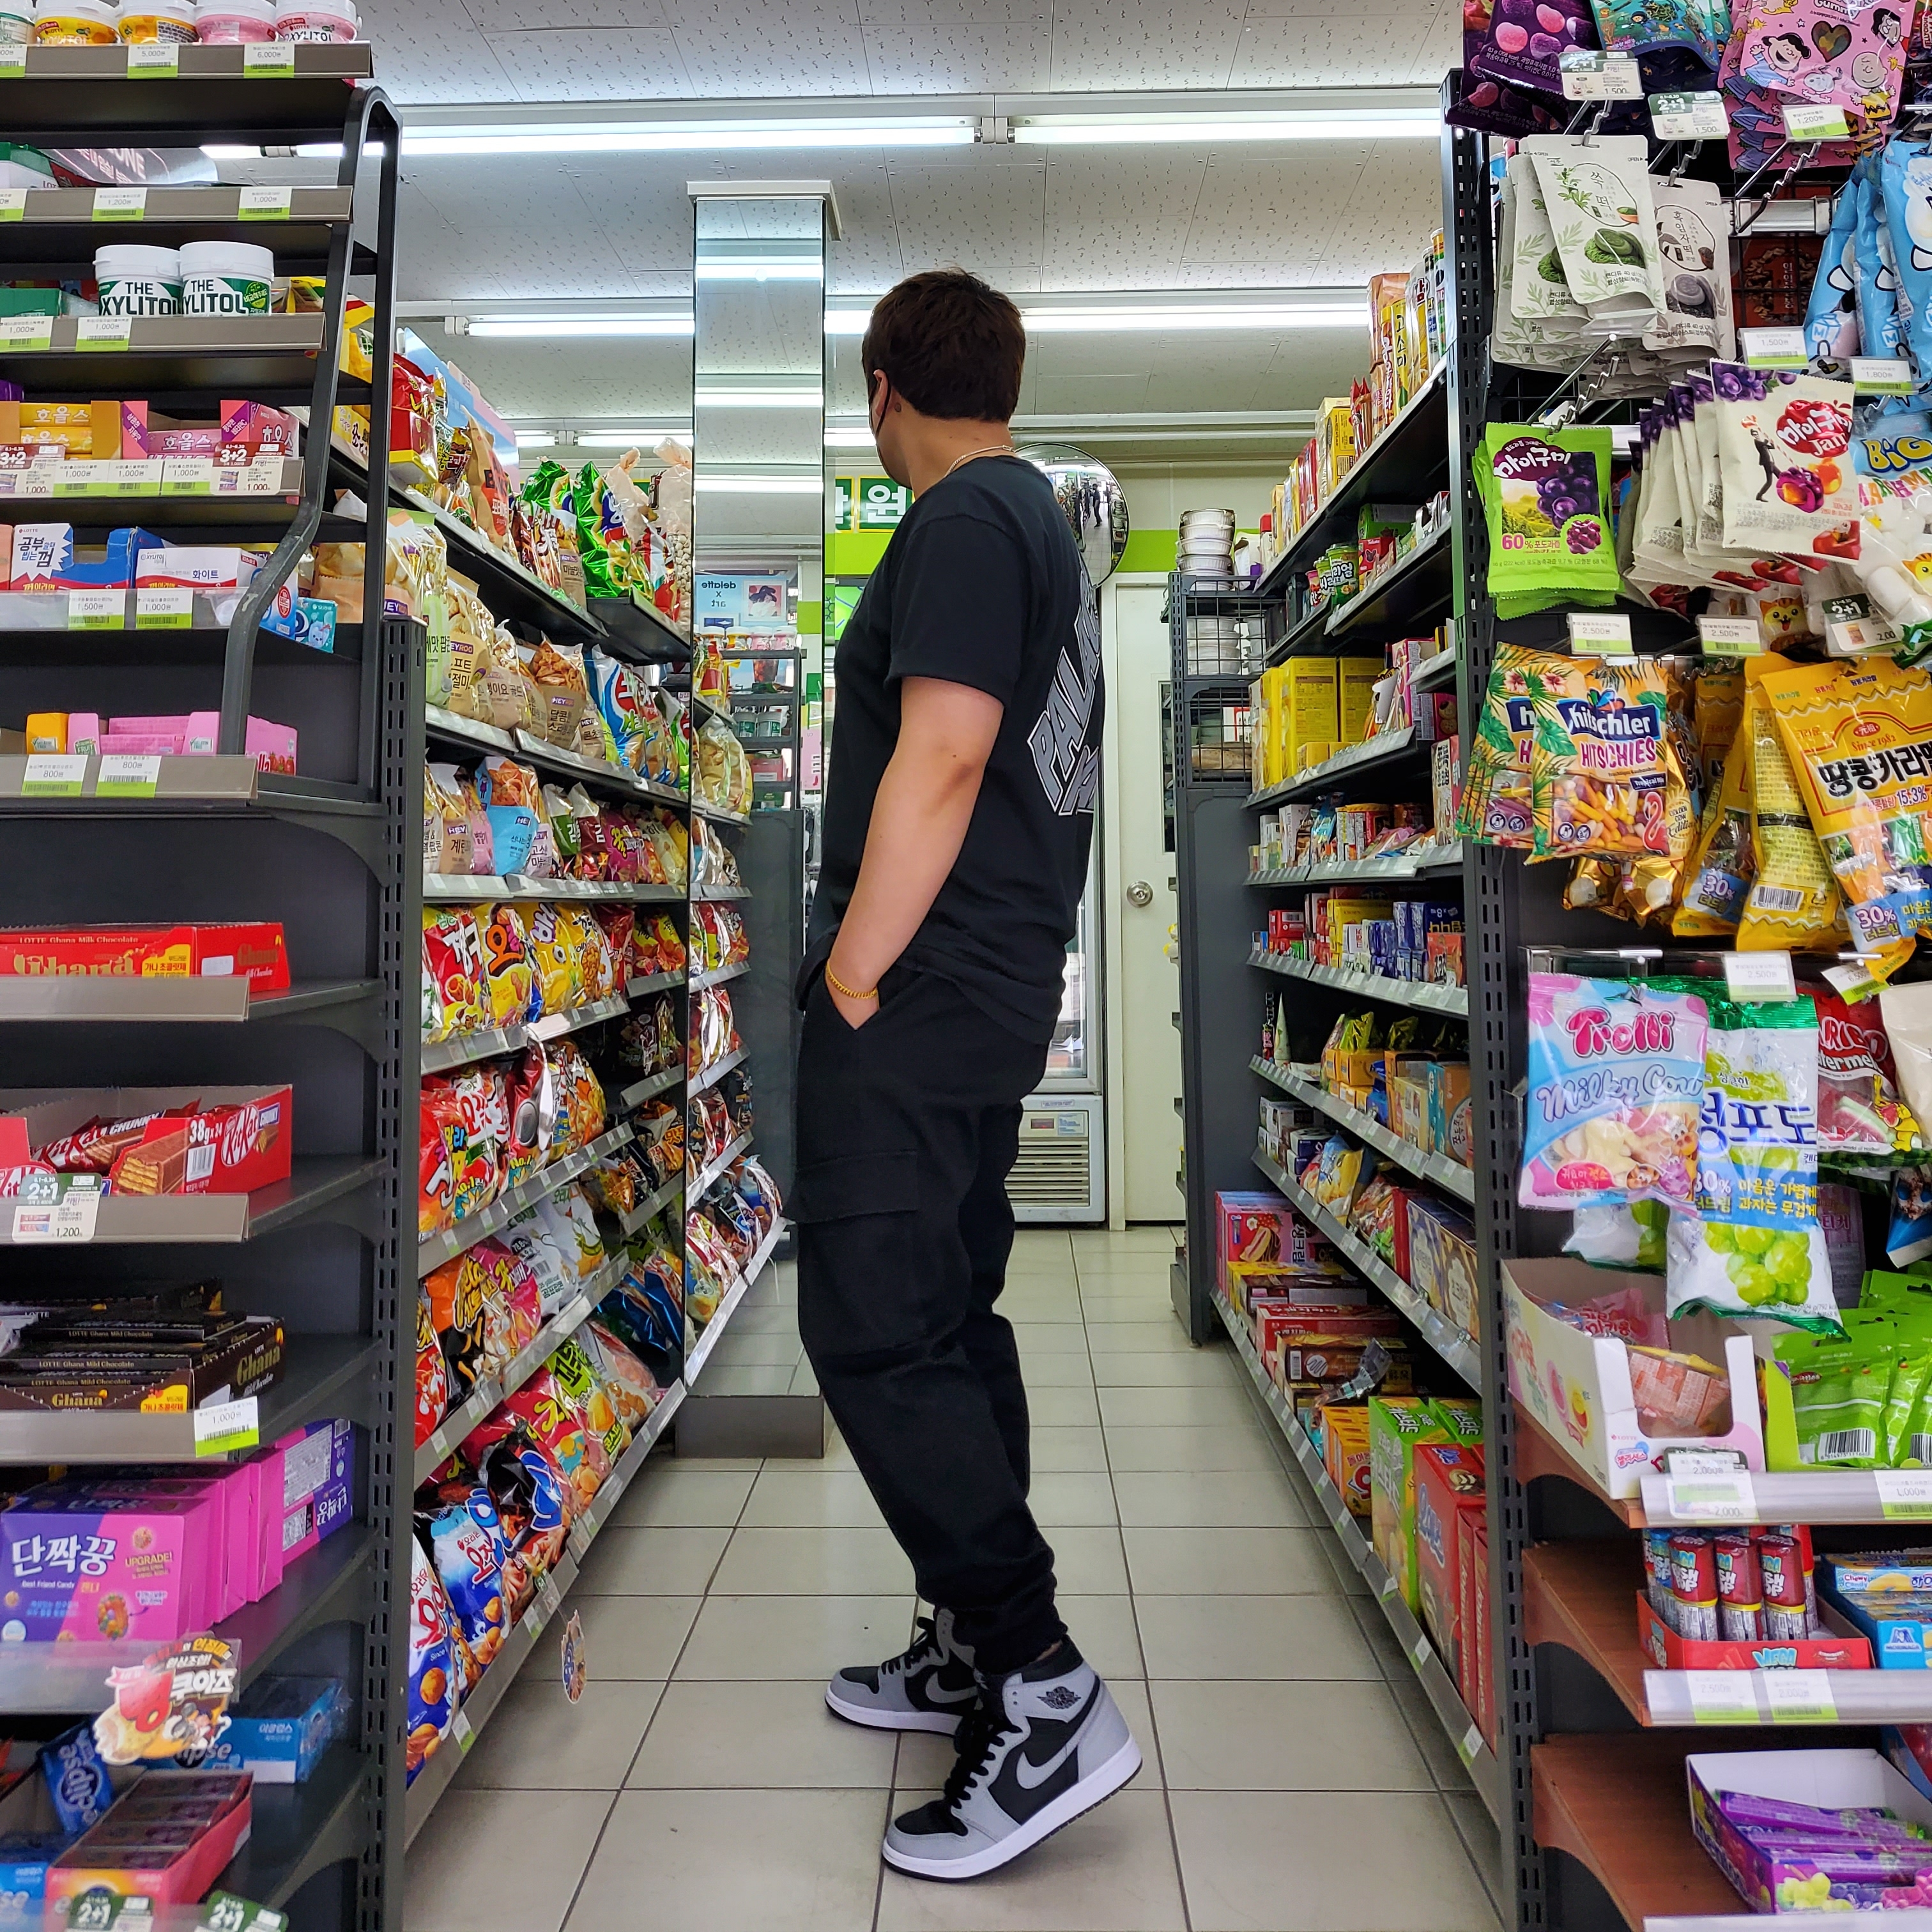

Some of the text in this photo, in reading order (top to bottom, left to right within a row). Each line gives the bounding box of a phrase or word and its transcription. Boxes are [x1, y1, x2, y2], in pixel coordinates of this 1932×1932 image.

[1568, 56, 1597, 68] 2+1
[1657, 98, 1685, 111] 2+1
[127, 282, 153, 295] THE
[191, 280, 214, 292] THE
[1397, 314, 1407, 367] 고소미
[34, 406, 90, 424] 호올스
[162, 432, 211, 450] 호올스
[0, 452, 26, 466] 3+2
[220, 449, 247, 463] 3+2
[1494, 447, 1572, 479] 마이구미
[17, 537, 45, 551] 공부
[1501, 534, 1524, 550] 60
[36, 548, 54, 567] 껌
[192, 569, 218, 580] 화이트
[1832, 604, 1861, 618] 2+1
[1570, 705, 1651, 737] hitschler
[1852, 734, 1897, 752] Since 1982
[1581, 739, 1657, 768] HITSCHIES
[1896, 785, 1929, 805] 15.3%
[1856, 905, 1896, 930] 30%
[144, 963, 158, 972] 가나
[1566, 1007, 1676, 1058] Trolli
[1537, 1064, 1703, 1123] Milky Cow
[109, 1113, 160, 1135] CHUNKY
[260, 1108, 279, 1126] CHUNKY
[512, 1155, 532, 1169] No.1
[27, 1183, 59, 1200] 2+1
[1739, 1197, 1777, 1215] 과자는
[55, 1227, 80, 1238] 1,200
[236, 1346, 281, 1387] Ghana
[52, 1392, 103, 1407] Ghana
[12, 1533, 117, 1576] 단짝꿍
[125, 1550, 173, 1568] UPGRADE!
[57, 1581, 75, 1589] Candy
[79, 1902, 111, 1928] 2+1
[209, 1903, 245, 1930] 2+1
